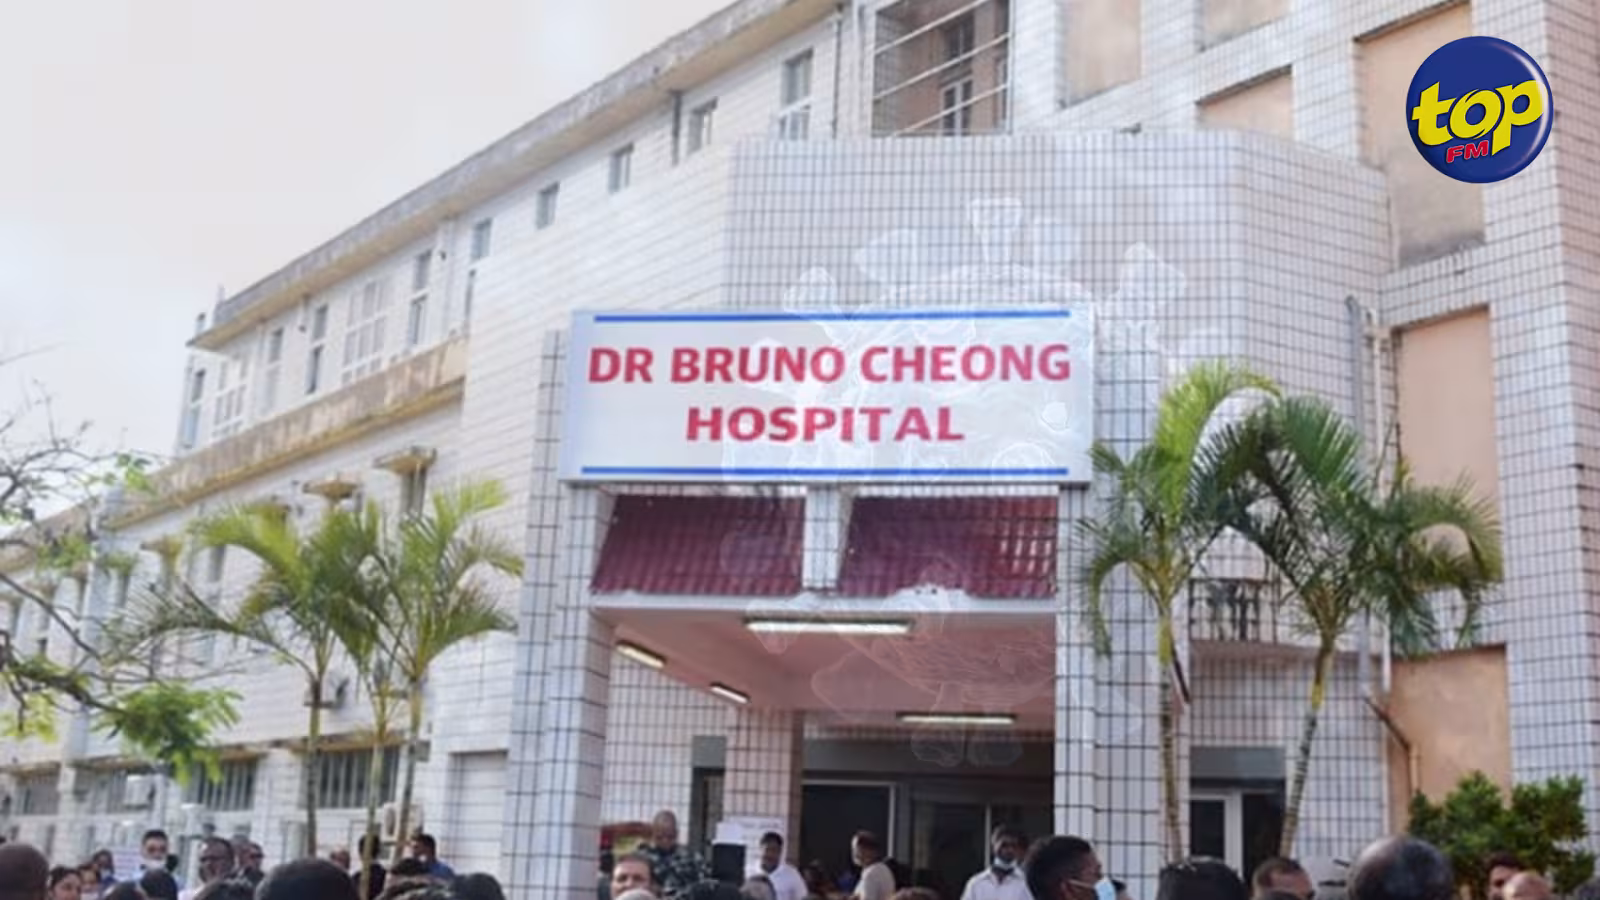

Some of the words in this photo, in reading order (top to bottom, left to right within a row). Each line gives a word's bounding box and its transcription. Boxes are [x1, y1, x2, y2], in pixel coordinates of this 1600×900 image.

[588, 347, 653, 384] DR
[670, 346, 845, 384] BRUNO
[860, 344, 1071, 383] CHEONG
[686, 407, 965, 442] HOSPITAL
